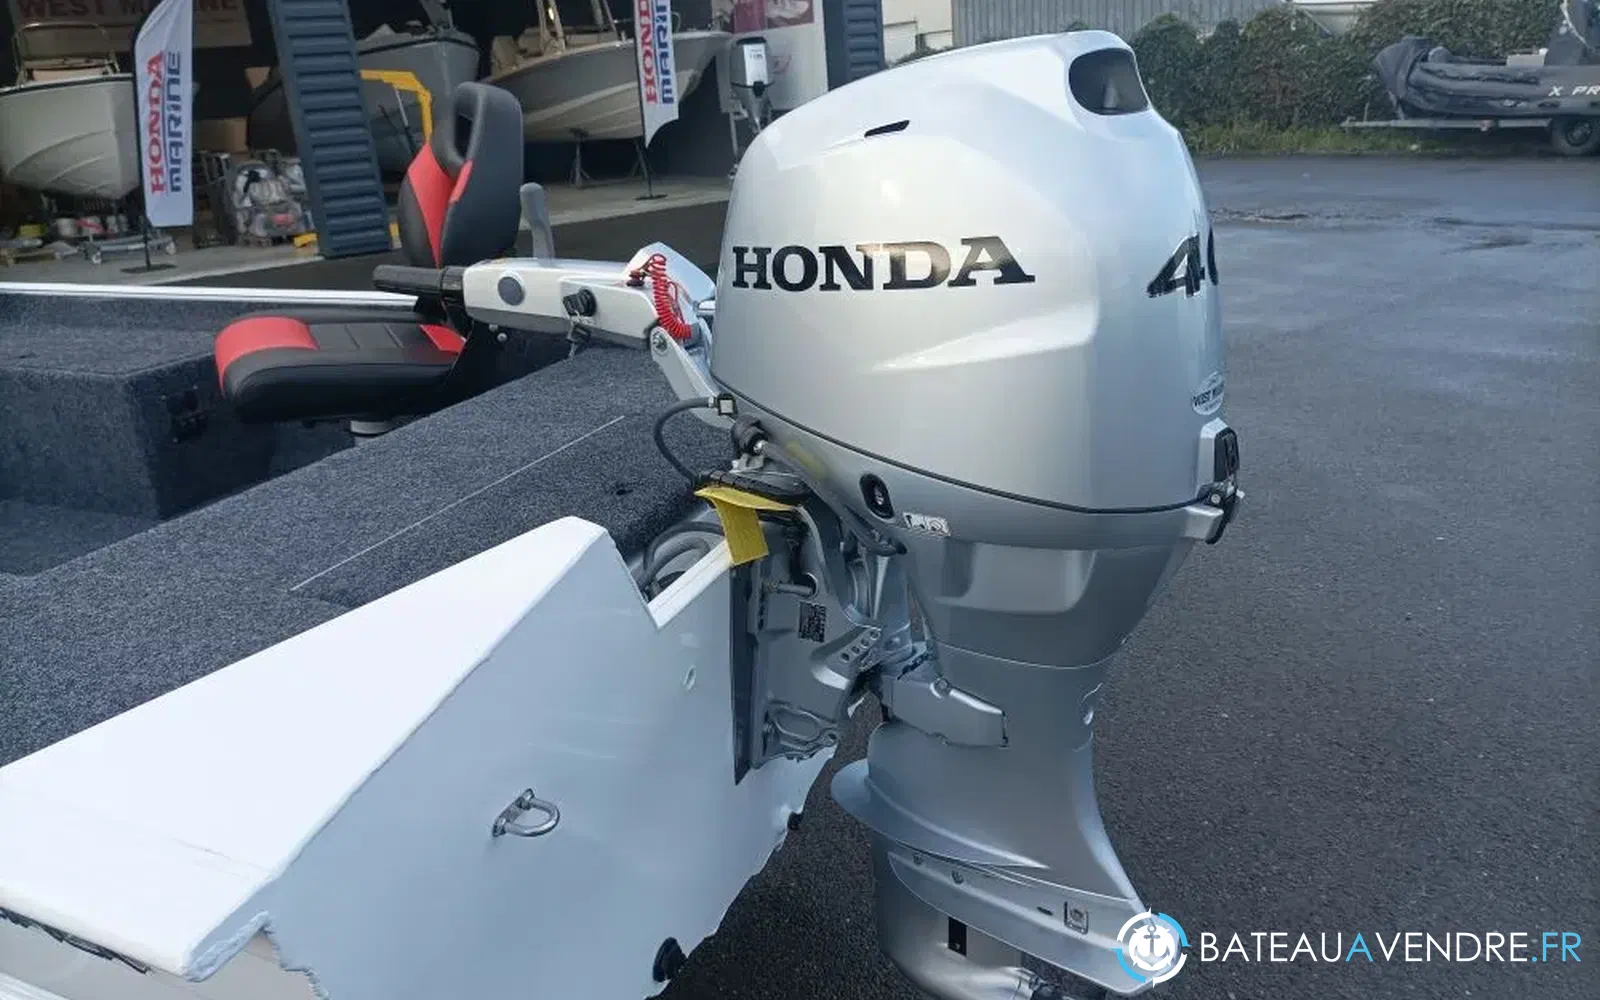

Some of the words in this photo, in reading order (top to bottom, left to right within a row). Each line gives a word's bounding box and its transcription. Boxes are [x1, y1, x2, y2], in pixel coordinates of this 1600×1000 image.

[639, 0, 658, 103] HOND
[1548, 86, 1564, 96] X
[1571, 85, 1600, 96] PR
[147, 51, 165, 193] HONDA
[167, 51, 183, 192] MARINE
[732, 235, 1036, 292] HONDA
